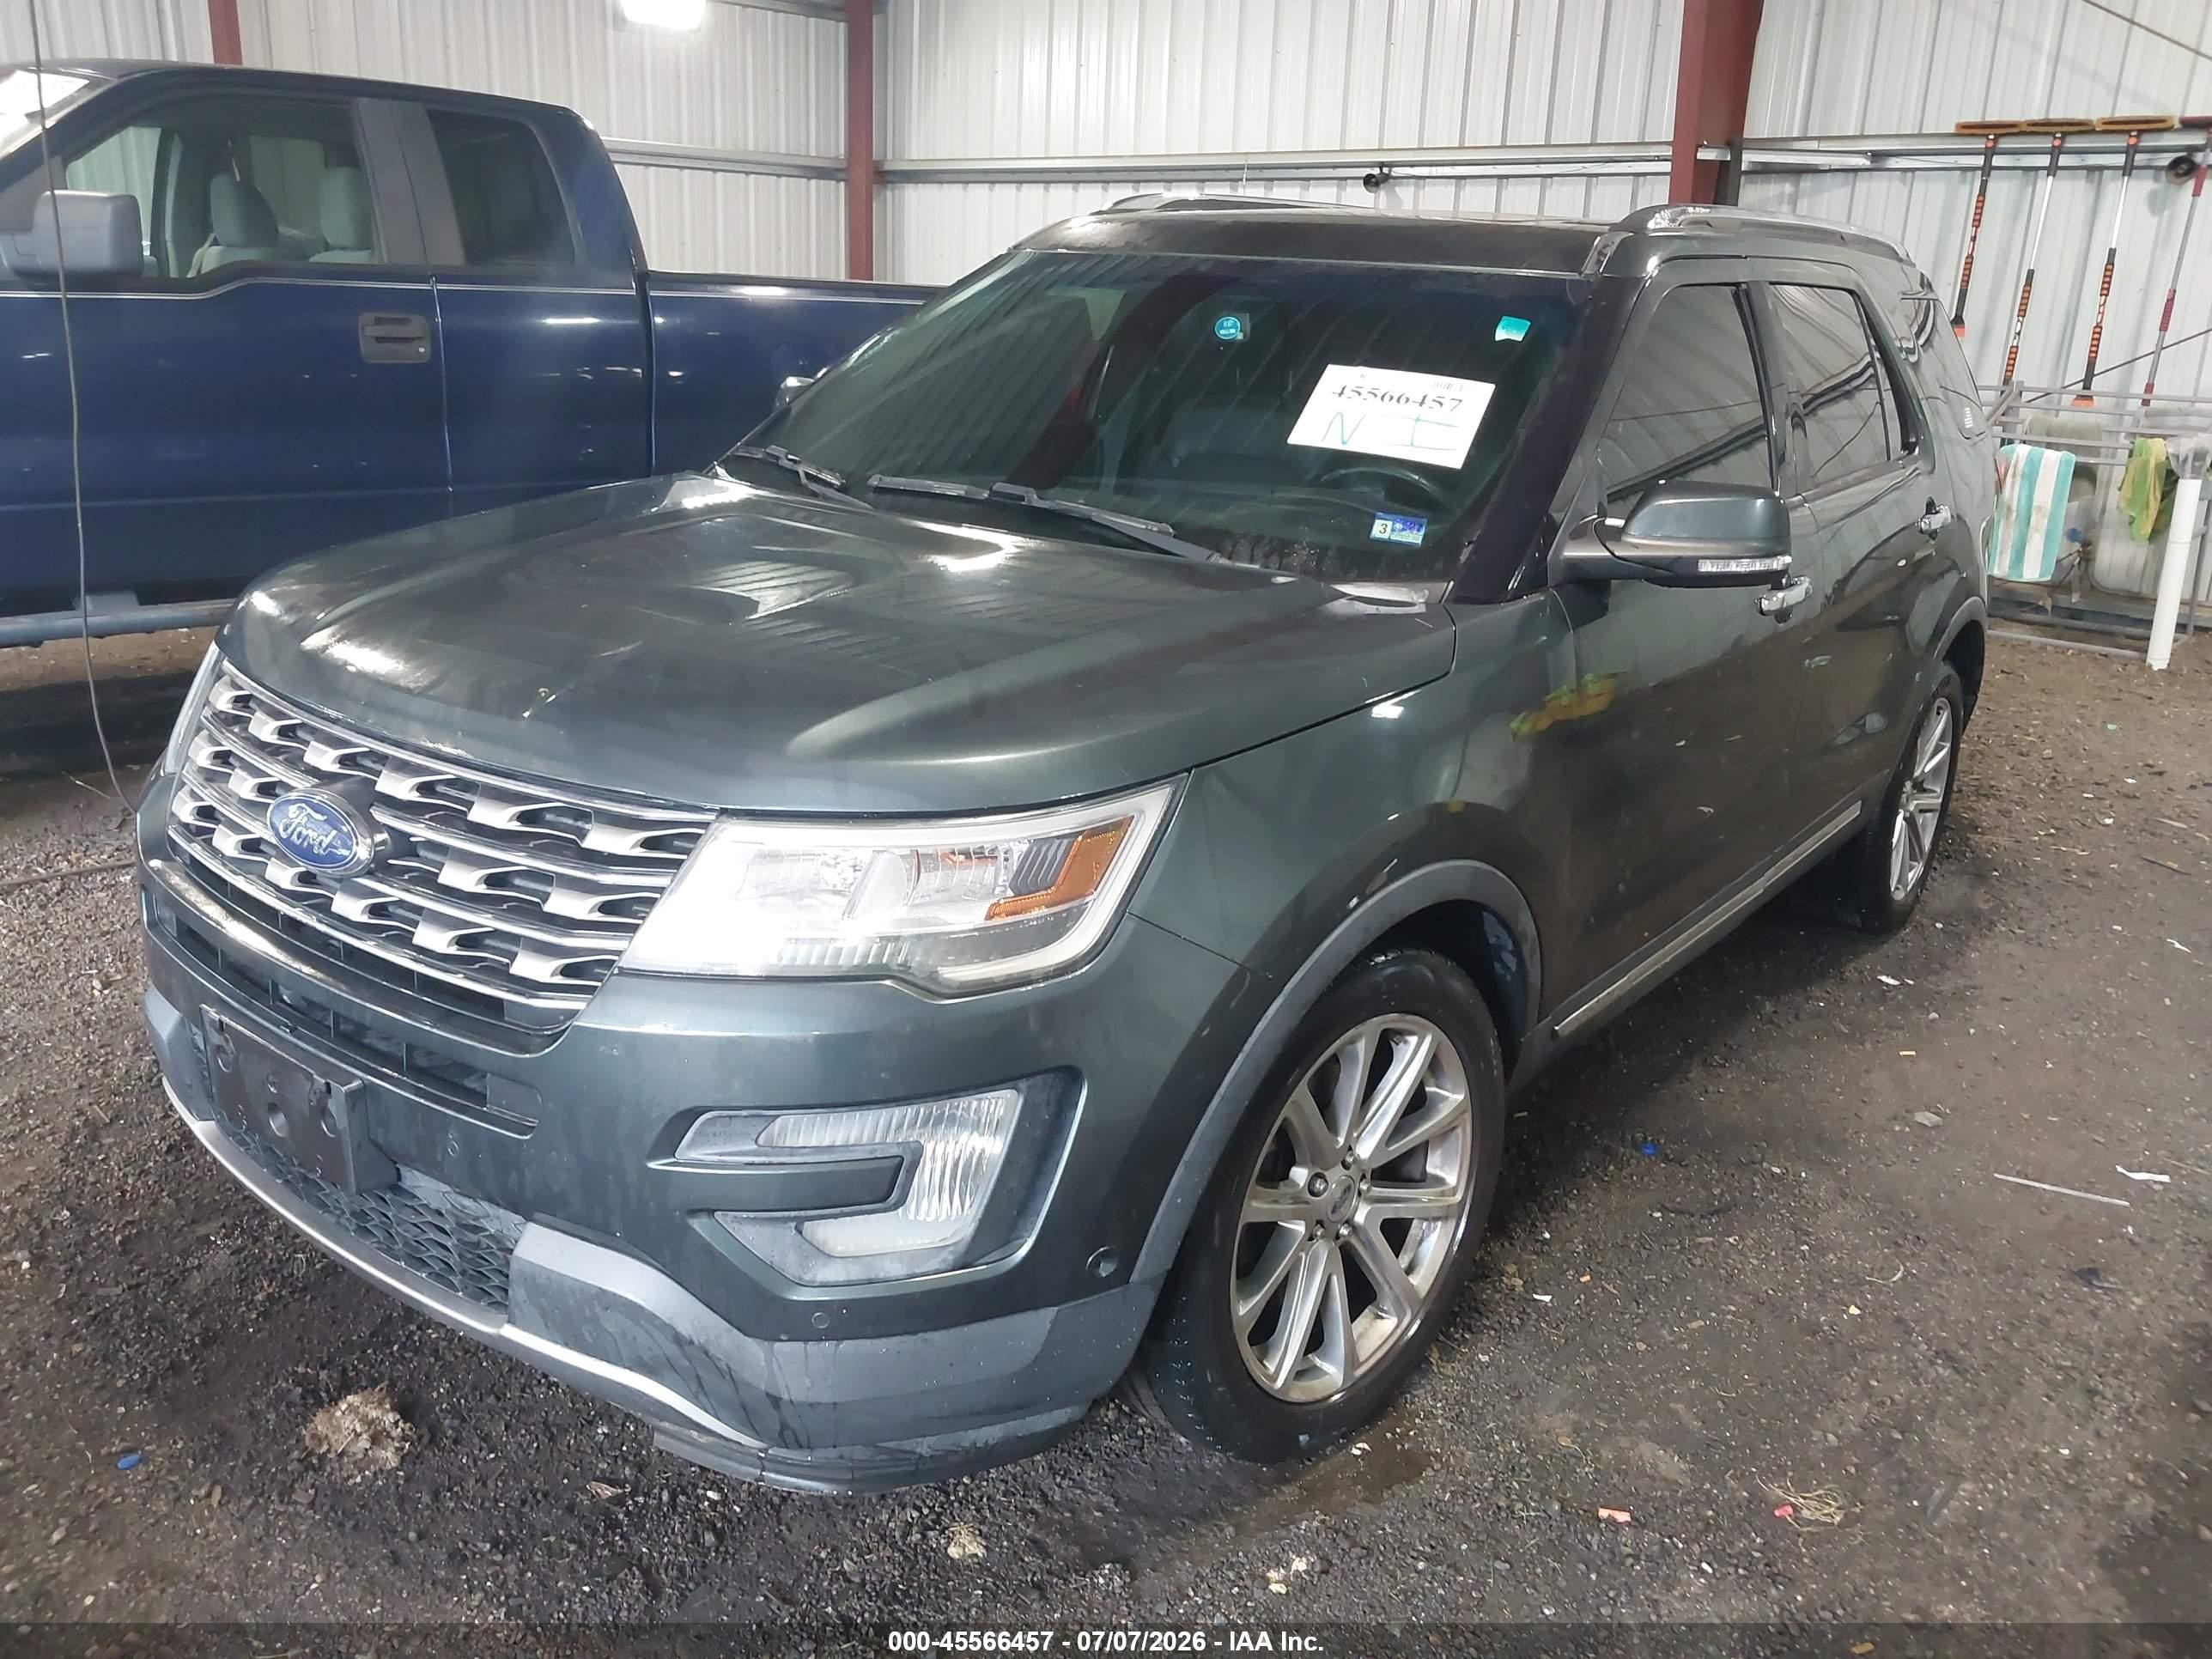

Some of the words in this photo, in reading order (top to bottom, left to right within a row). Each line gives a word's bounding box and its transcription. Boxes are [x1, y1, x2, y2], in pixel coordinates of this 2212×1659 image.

[1332, 385, 1463, 412] 45566457
[1321, 412, 1367, 446] N
[1379, 523, 1389, 534] 3
[279, 803, 352, 856] Ford
